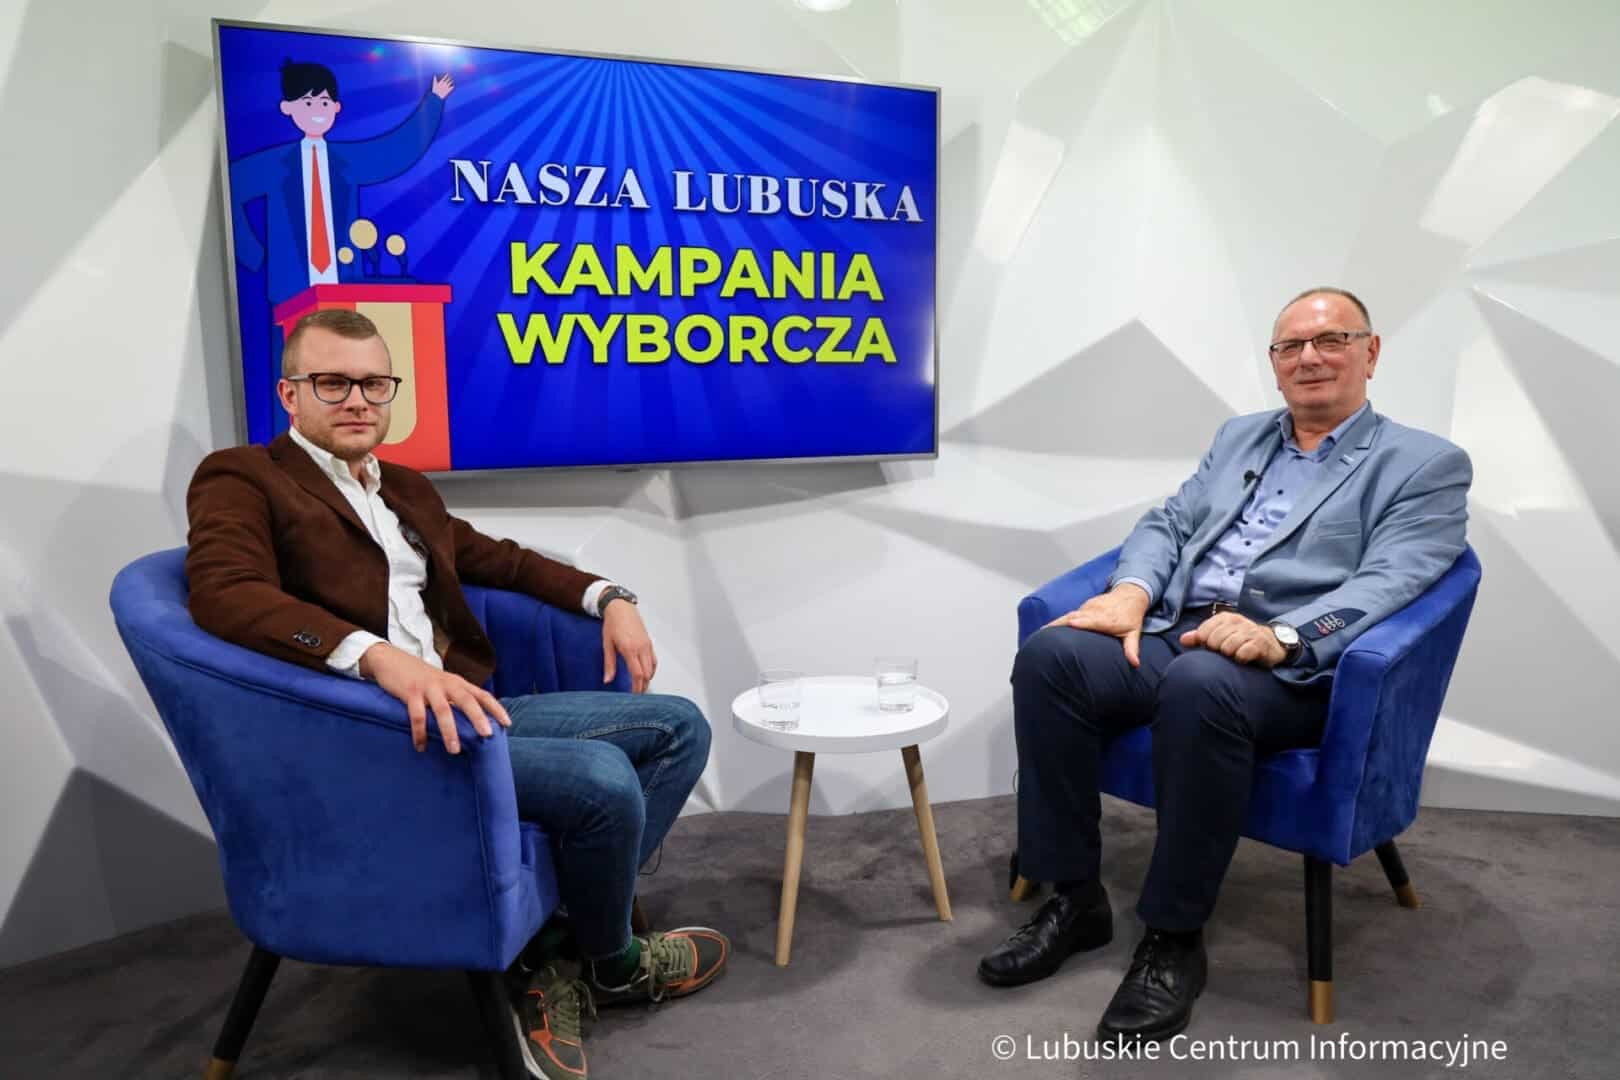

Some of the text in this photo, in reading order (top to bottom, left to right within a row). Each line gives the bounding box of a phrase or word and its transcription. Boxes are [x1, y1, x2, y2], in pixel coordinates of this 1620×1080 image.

[451, 159, 922, 223] NASZA LUBUSKA
[511, 242, 884, 301] KAMPANIA
[497, 313, 897, 364] WYBORCZA
